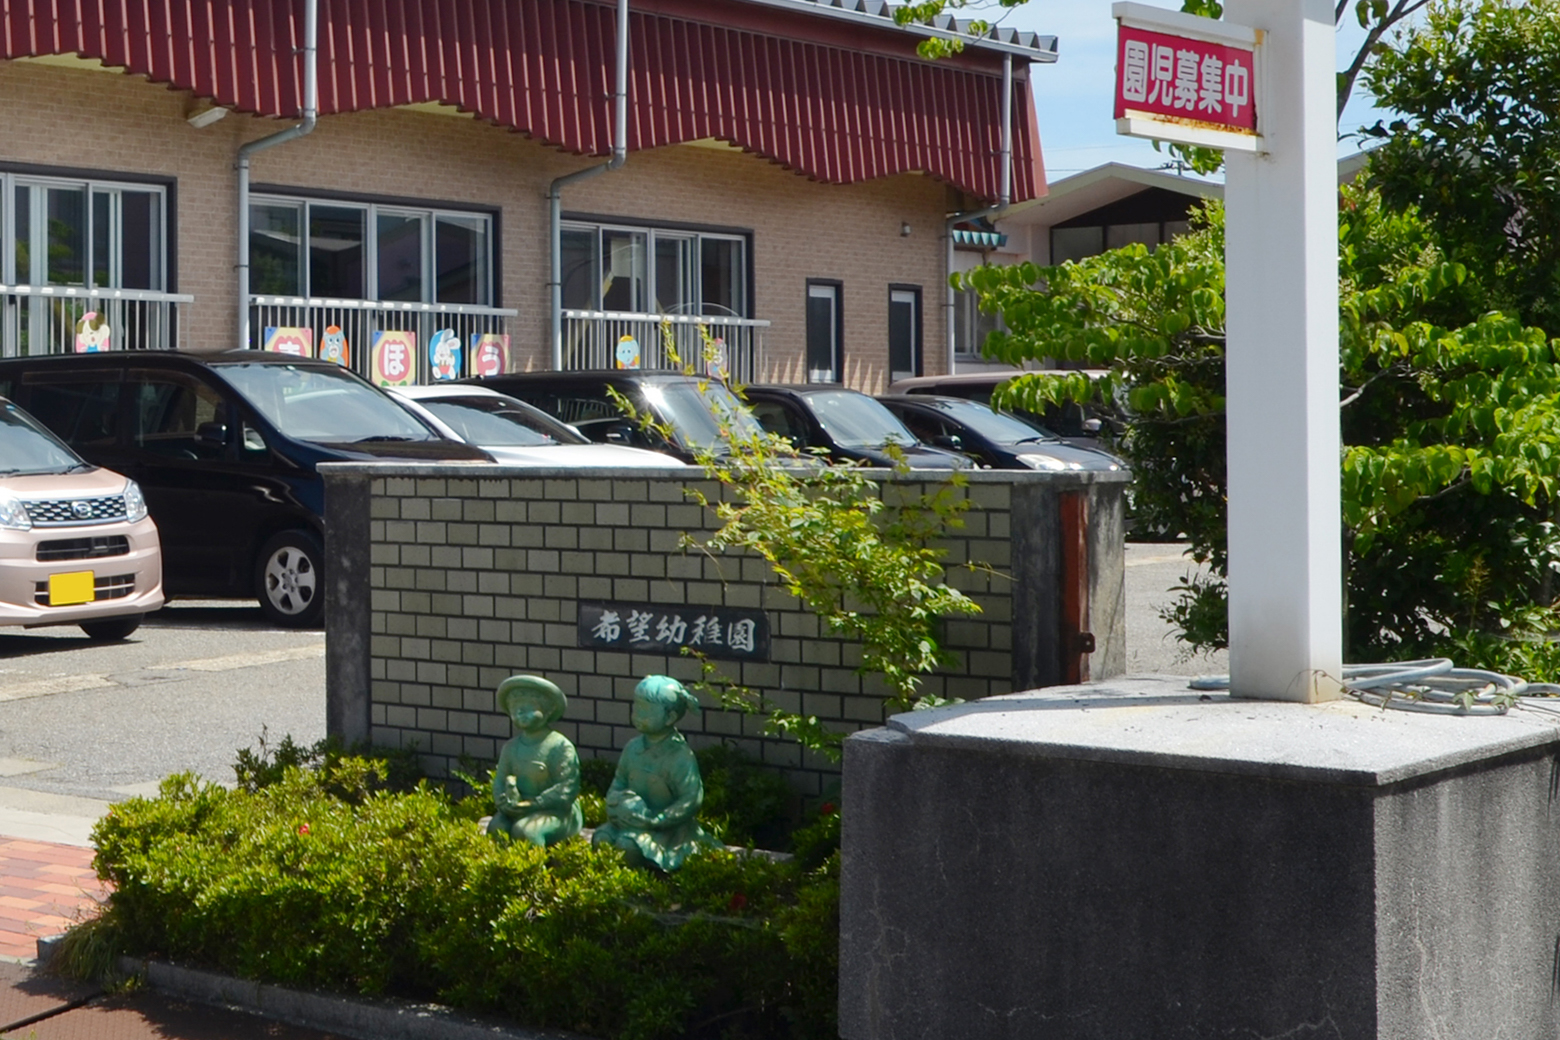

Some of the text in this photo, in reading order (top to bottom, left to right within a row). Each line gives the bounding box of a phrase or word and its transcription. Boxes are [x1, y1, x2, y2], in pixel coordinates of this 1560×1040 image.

[1122, 39, 1249, 118] 園児募集中
[591, 609, 756, 653] 希望幼稚園
